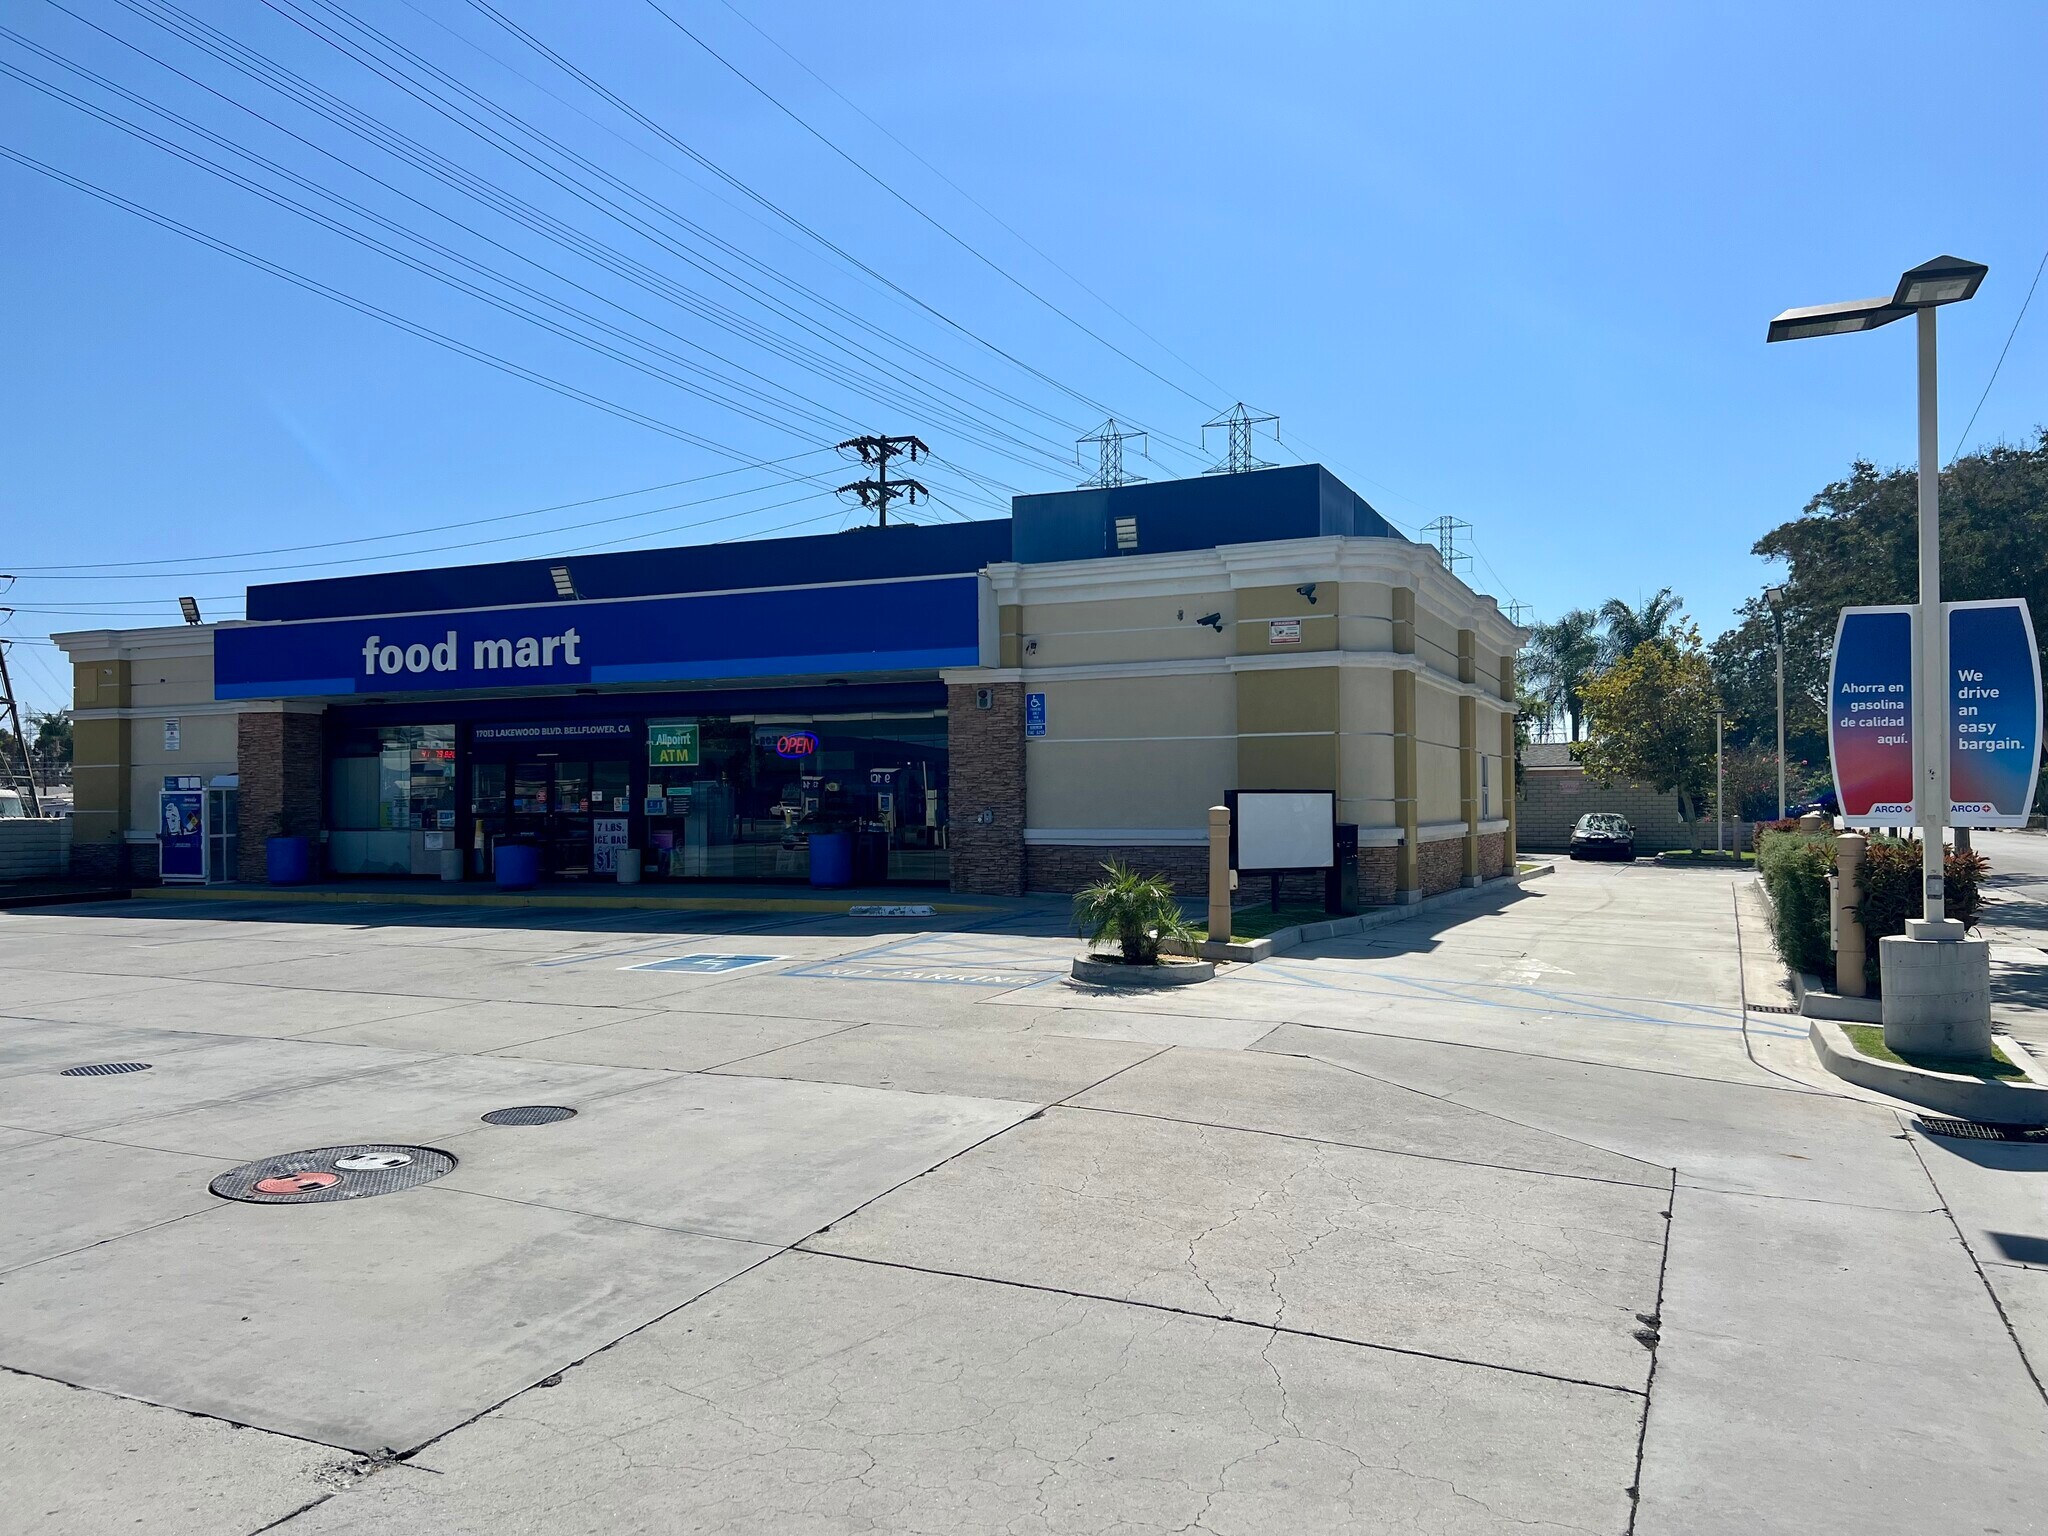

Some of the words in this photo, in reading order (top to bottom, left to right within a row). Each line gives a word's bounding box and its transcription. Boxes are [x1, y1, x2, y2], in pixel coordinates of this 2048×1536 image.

[362, 630, 457, 675] food
[473, 627, 581, 670] mart
[1958, 669, 1983, 682] We
[1841, 682, 1885, 693] Ahorra
[1888, 684, 1904, 693] en
[1958, 686, 2000, 699] drive
[1850, 699, 1904, 713] gasolina
[1958, 705, 1978, 716] an
[1840, 717, 1856, 727] de
[1859, 716, 1904, 727] calidad
[1958, 721, 1997, 735] easy
[495, 728, 540, 738] LAKEWOOD
[618, 725, 631, 734] CA
[657, 732, 691, 748] Allpoint
[777, 736, 814, 755] OPEN
[1877, 732, 1908, 746] aquí.
[1958, 738, 2025, 753] bargain.
[659, 749, 689, 763] ATM
[1874, 804, 1902, 813] ARCO
[1950, 804, 1980, 813] ARCO
[597, 822, 603, 832] 7
[605, 822, 624, 832] LBS.
[595, 835, 607, 844] ICE
[610, 835, 627, 845] BAG
[826, 968, 874, 977] NO
[883, 970, 1038, 985] PARKING
